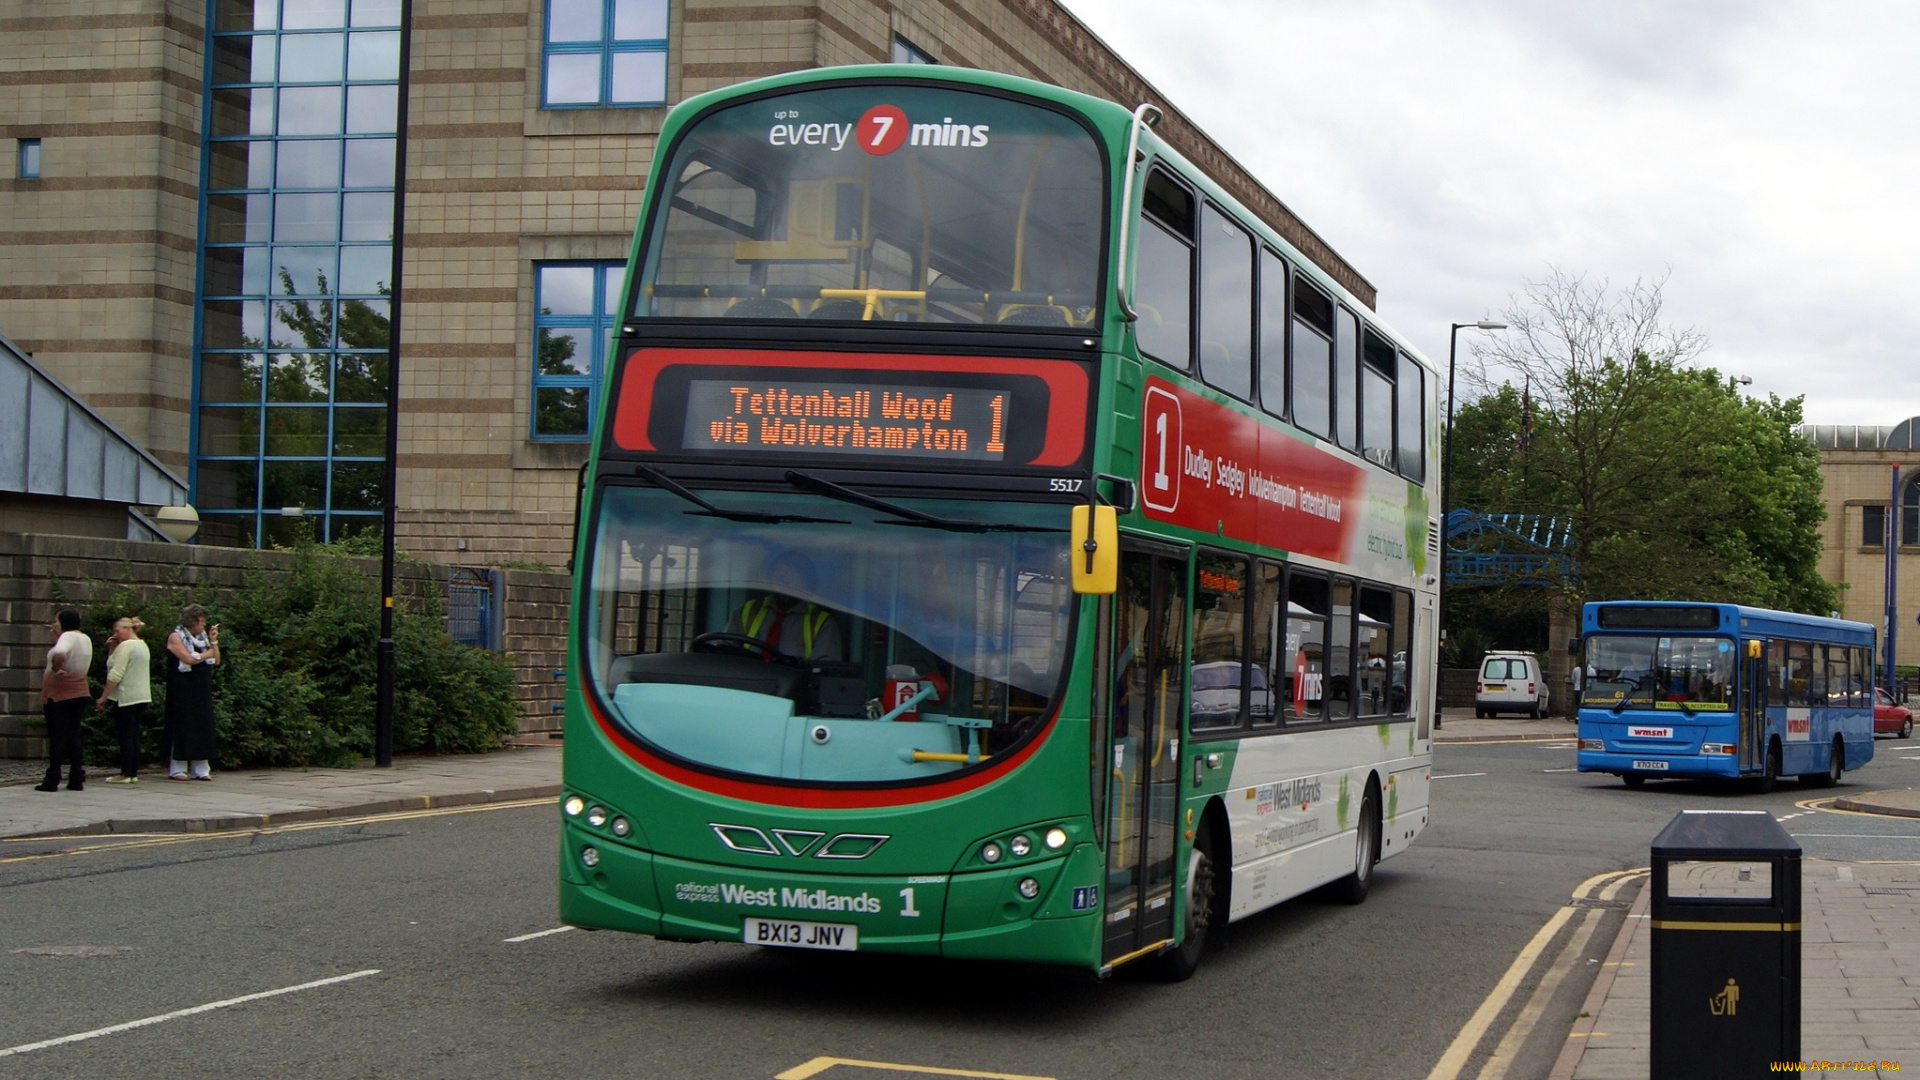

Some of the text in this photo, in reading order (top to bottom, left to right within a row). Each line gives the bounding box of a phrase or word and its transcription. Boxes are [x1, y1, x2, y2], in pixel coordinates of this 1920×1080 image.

[774, 110, 799, 120] up to
[769, 116, 990, 151] every 7 mins
[730, 387, 952, 420] Tettenhall Wood
[710, 416, 968, 451] via Wolverhampton
[986, 395, 1005, 452] 1
[1154, 412, 1169, 491] 1
[1050, 479, 1082, 492] 5517
[1184, 444, 1213, 488] Dudley
[1216, 456, 1245, 498] Sedgley
[1249, 468, 1297, 511] Wolverhampton
[1299, 486, 1326, 517] Tettenhall
[1326, 497, 1341, 523] Wood
[1285, 633, 1300, 656] every
[1297, 664, 1323, 701] 7 mins
[1615, 691, 1625, 700] 61
[1634, 729, 1667, 737] wmsnt
[1787, 715, 1809, 734] wmsnt
[1273, 775, 1321, 811] West Midlands
[675, 882, 719, 894] national
[676, 892, 720, 903] express
[721, 884, 881, 913] West Midlands
[900, 887, 920, 917] 1
[758, 922, 844, 946] BX13 JNV
